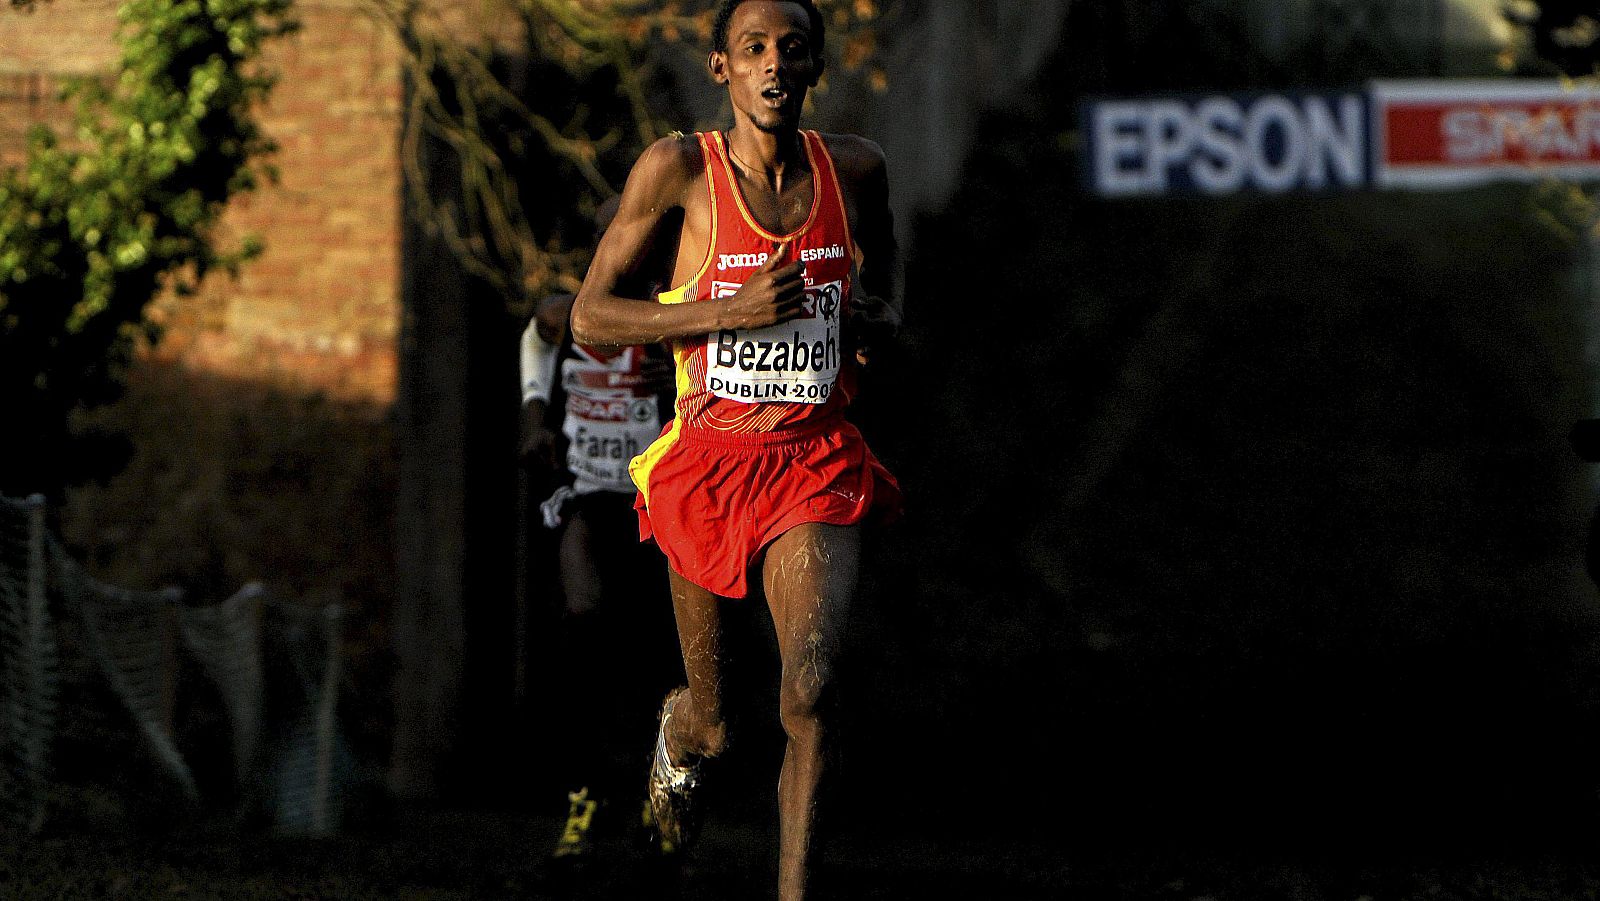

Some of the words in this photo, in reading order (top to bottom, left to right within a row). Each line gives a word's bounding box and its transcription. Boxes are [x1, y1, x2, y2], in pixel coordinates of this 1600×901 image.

[1094, 97, 1366, 194] EPSON
[800, 244, 845, 262] ESPAÑA
[716, 328, 837, 372] Bezabeh
[709, 377, 787, 399] DUBLIN
[576, 426, 638, 459] Farah
